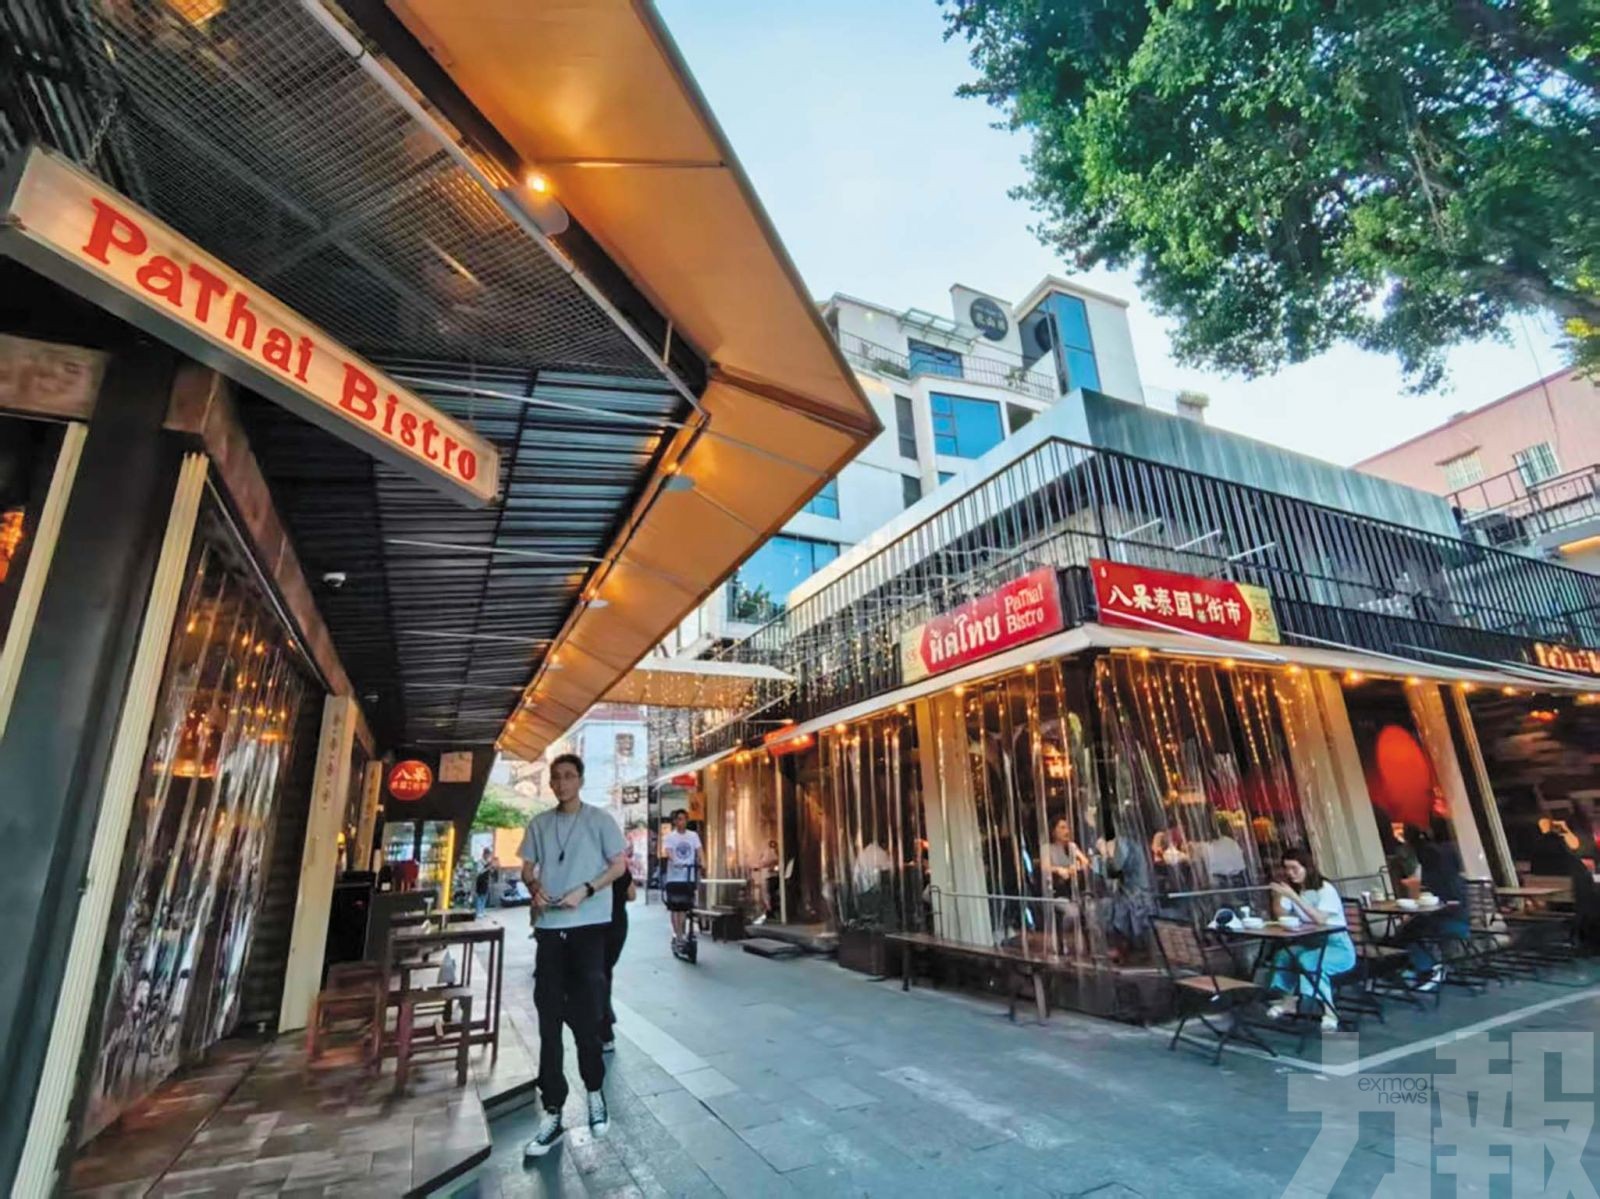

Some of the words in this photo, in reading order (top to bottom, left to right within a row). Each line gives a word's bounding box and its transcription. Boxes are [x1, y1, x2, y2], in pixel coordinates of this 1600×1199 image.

[82, 197, 318, 384] PaThai
[339, 362, 477, 482] Bistro
[1006, 608, 1044, 634] Bistro
